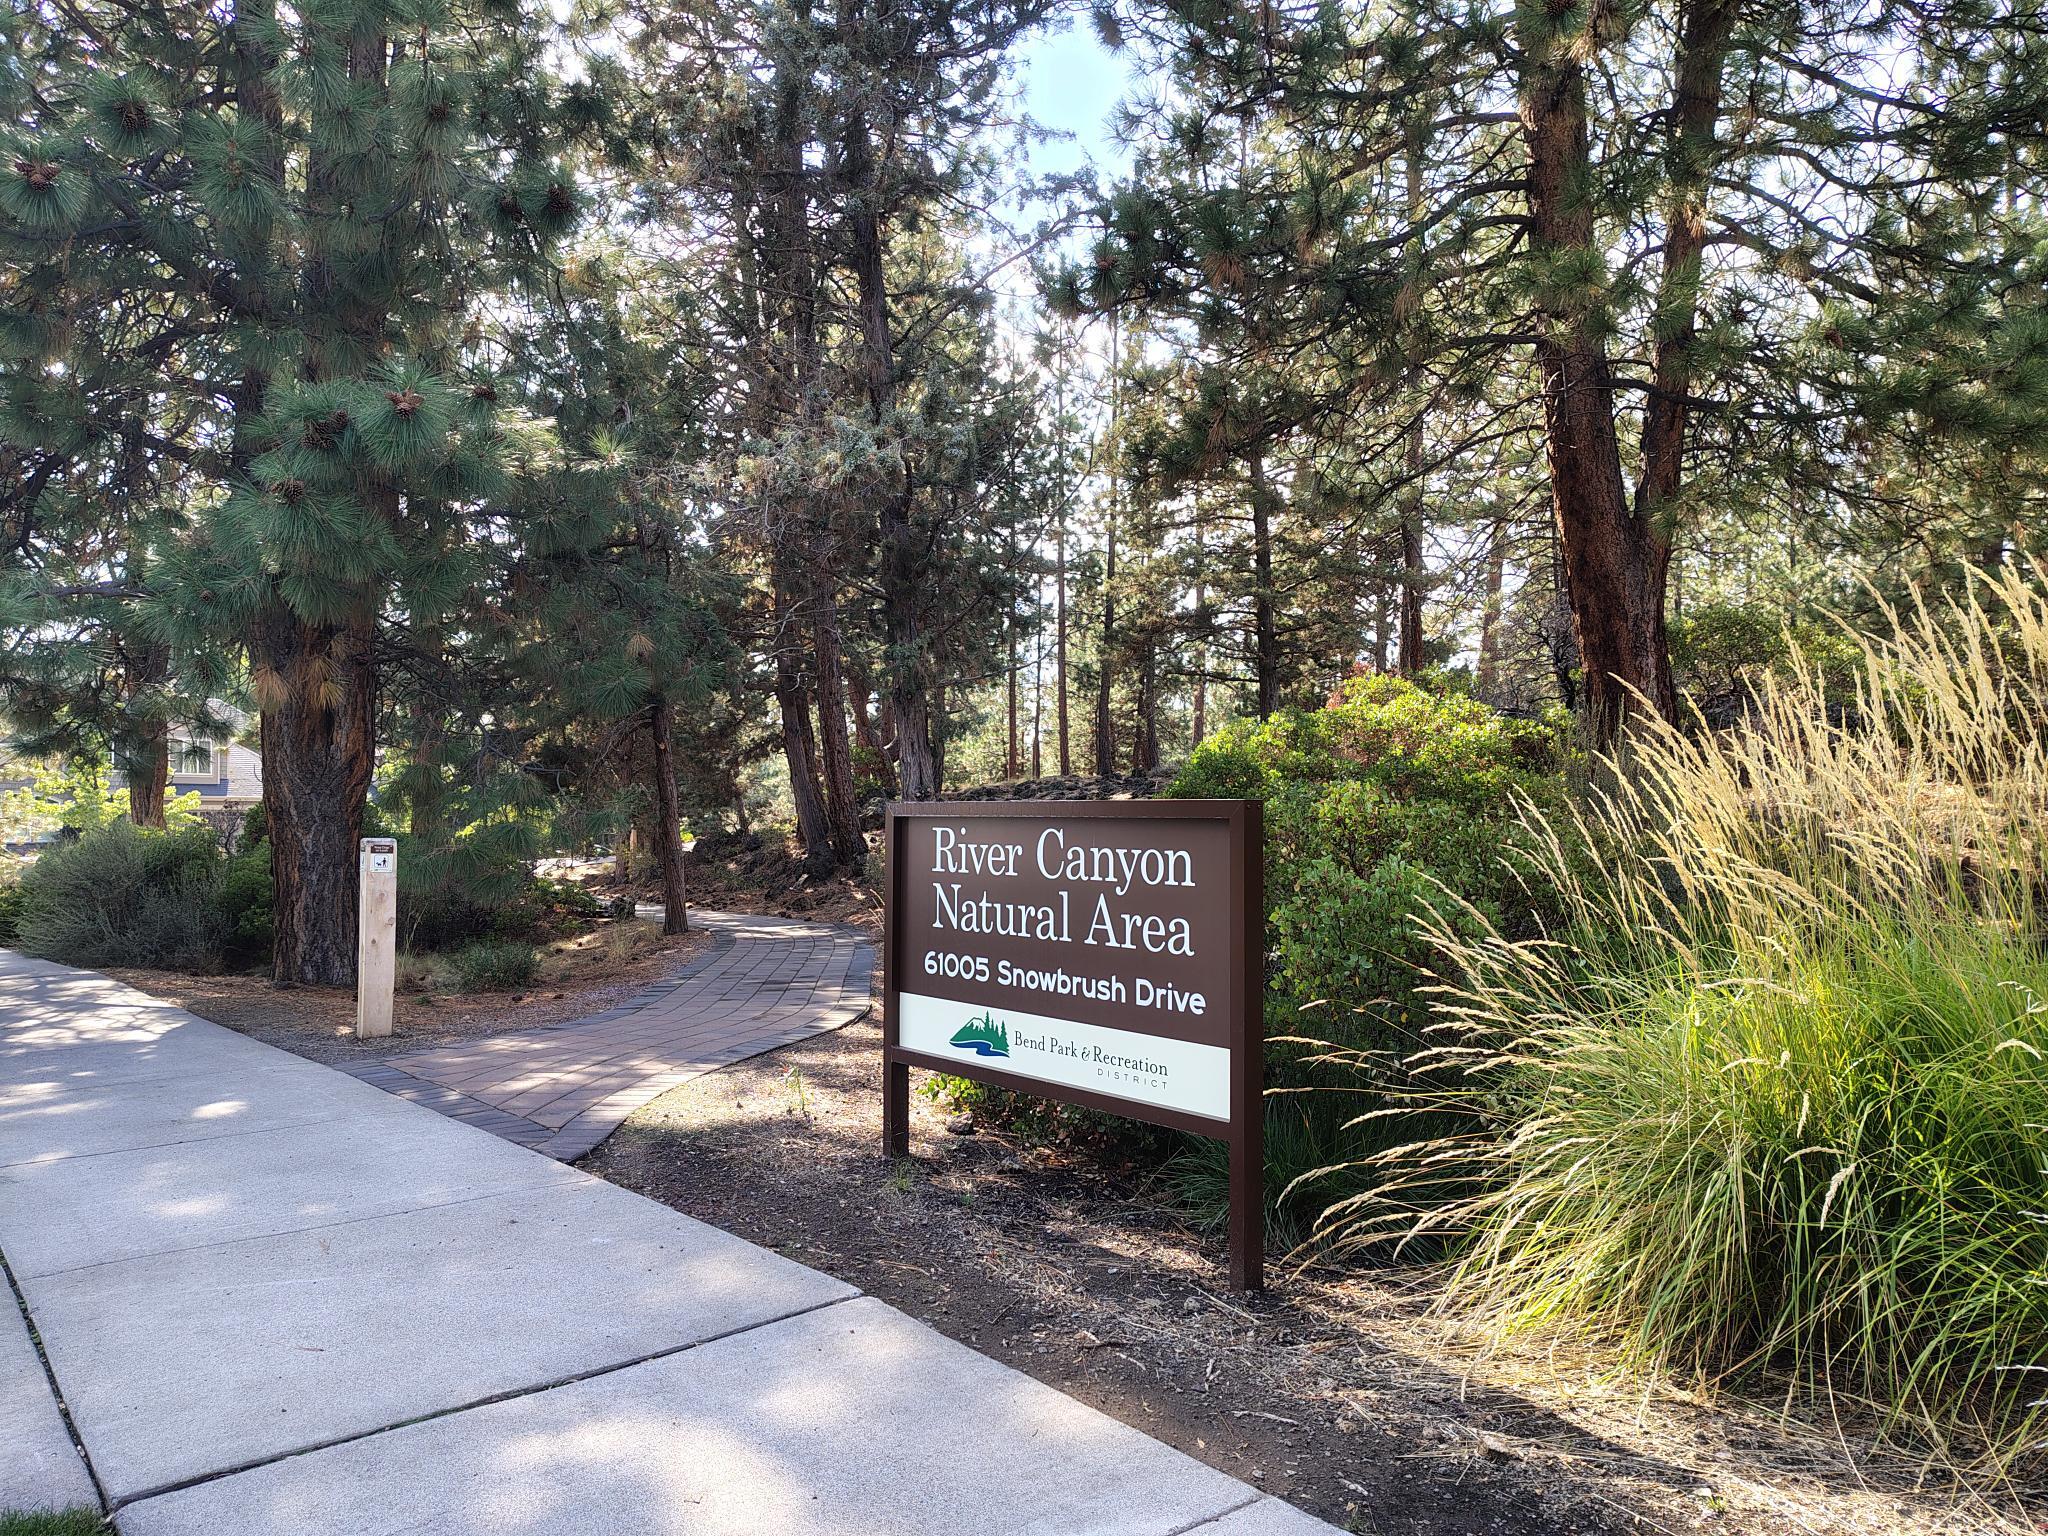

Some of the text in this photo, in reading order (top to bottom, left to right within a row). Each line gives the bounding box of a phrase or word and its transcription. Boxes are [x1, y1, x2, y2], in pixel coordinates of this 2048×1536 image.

[931, 827, 1196, 896] River Canyon
[932, 882, 1195, 957] Natural Area
[924, 951, 1206, 1015] 61005 Snowbrush Drive
[1014, 1031, 1168, 1077] Bend Park & Recreation
[1097, 1068, 1168, 1090] DISTRICT
